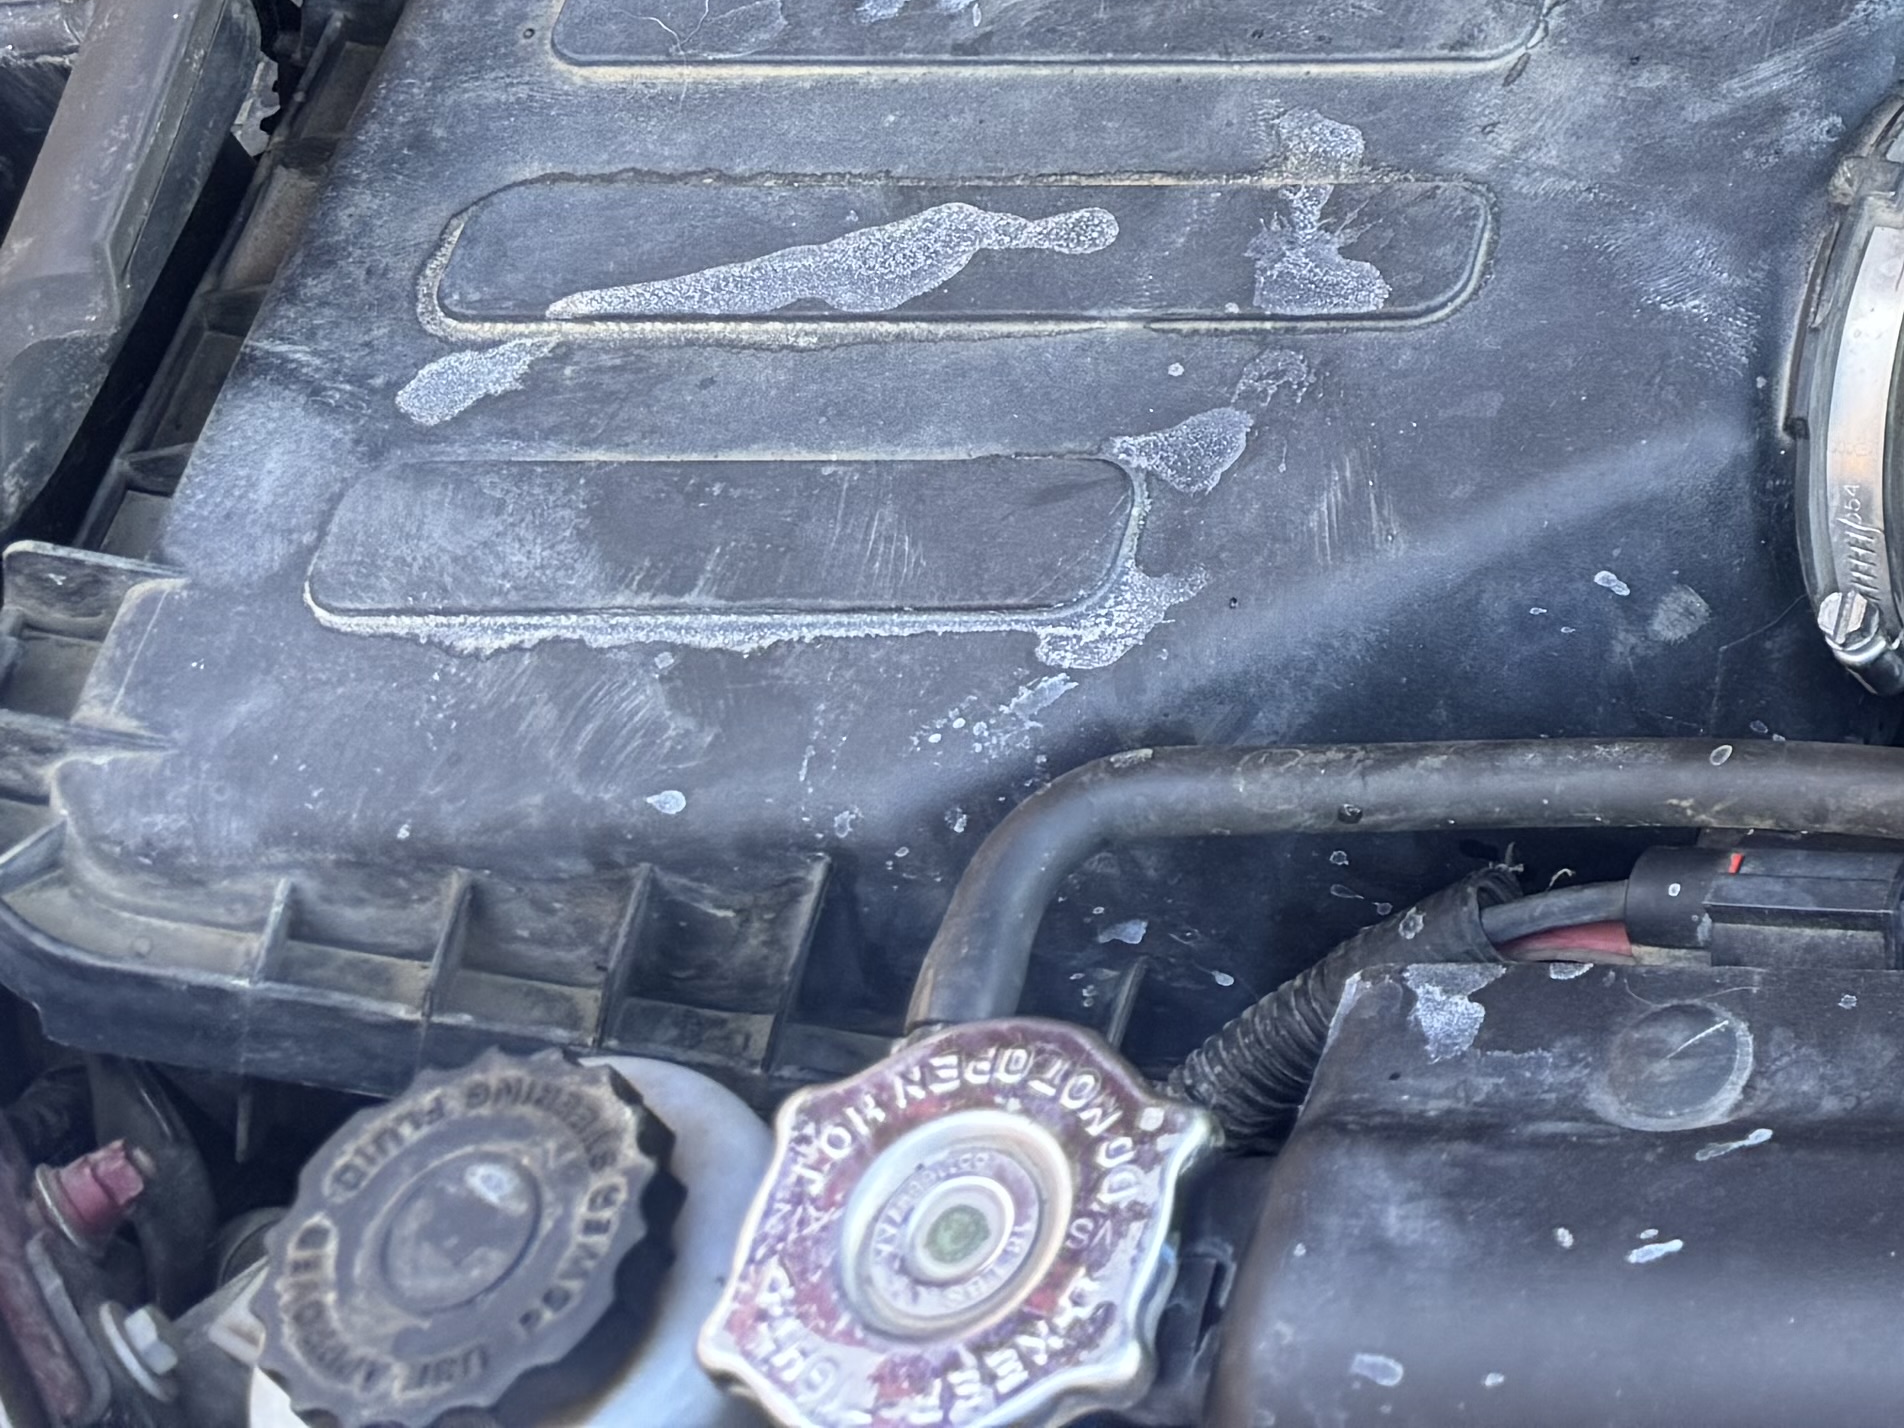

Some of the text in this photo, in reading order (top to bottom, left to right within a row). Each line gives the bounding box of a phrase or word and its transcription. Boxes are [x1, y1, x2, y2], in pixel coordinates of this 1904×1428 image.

[893, 1047, 1032, 1109] OPEN
[328, 1096, 448, 1198] FLUID
[794, 1093, 888, 1197] HOT
